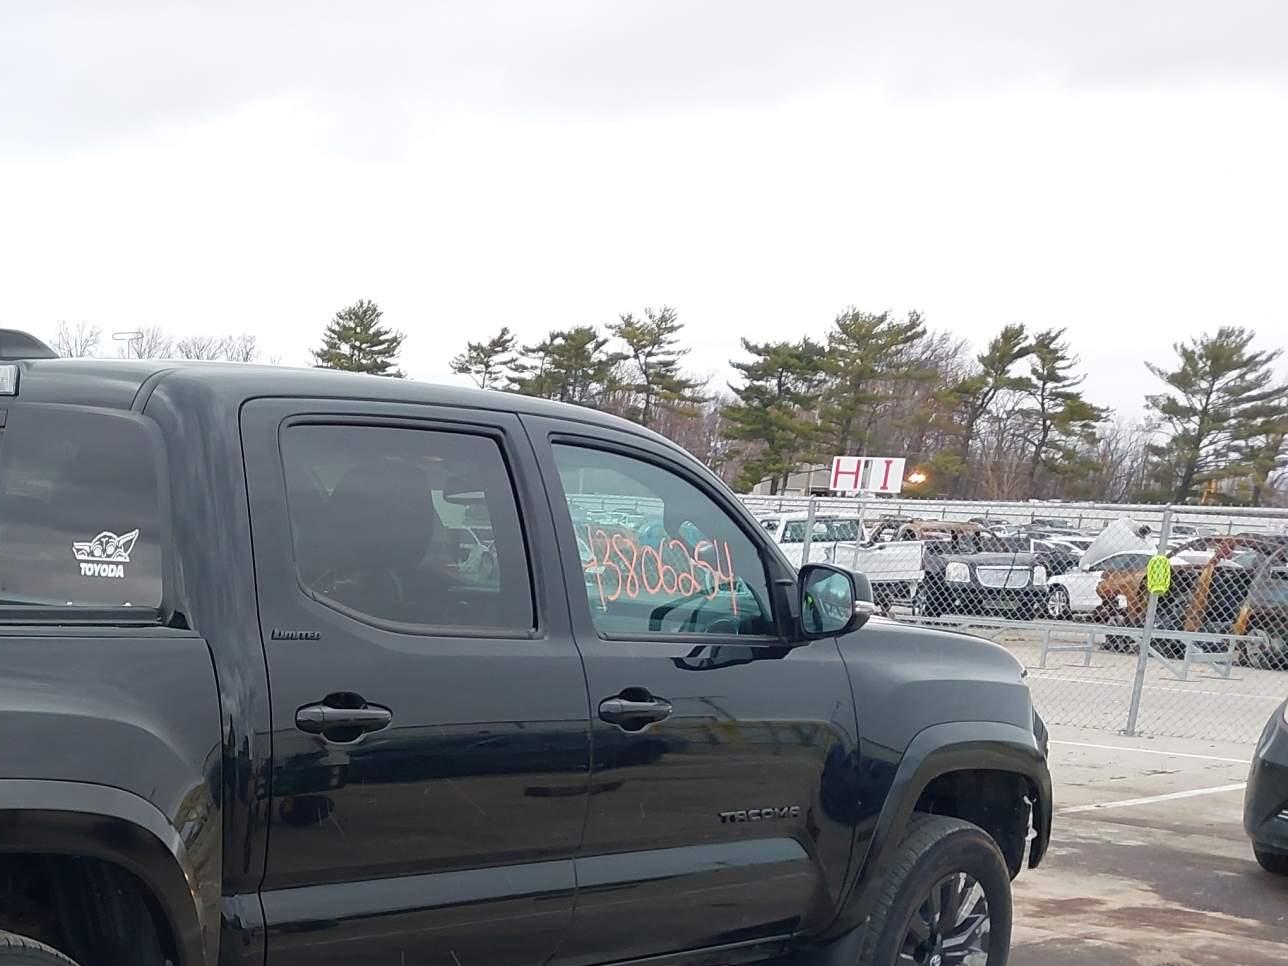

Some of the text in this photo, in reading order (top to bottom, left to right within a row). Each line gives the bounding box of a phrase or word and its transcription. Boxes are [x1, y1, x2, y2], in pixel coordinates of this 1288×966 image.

[79, 562, 125, 578] TOYODA
[583, 525, 737, 616] 43806254
[717, 806, 801, 824] TACOMA
